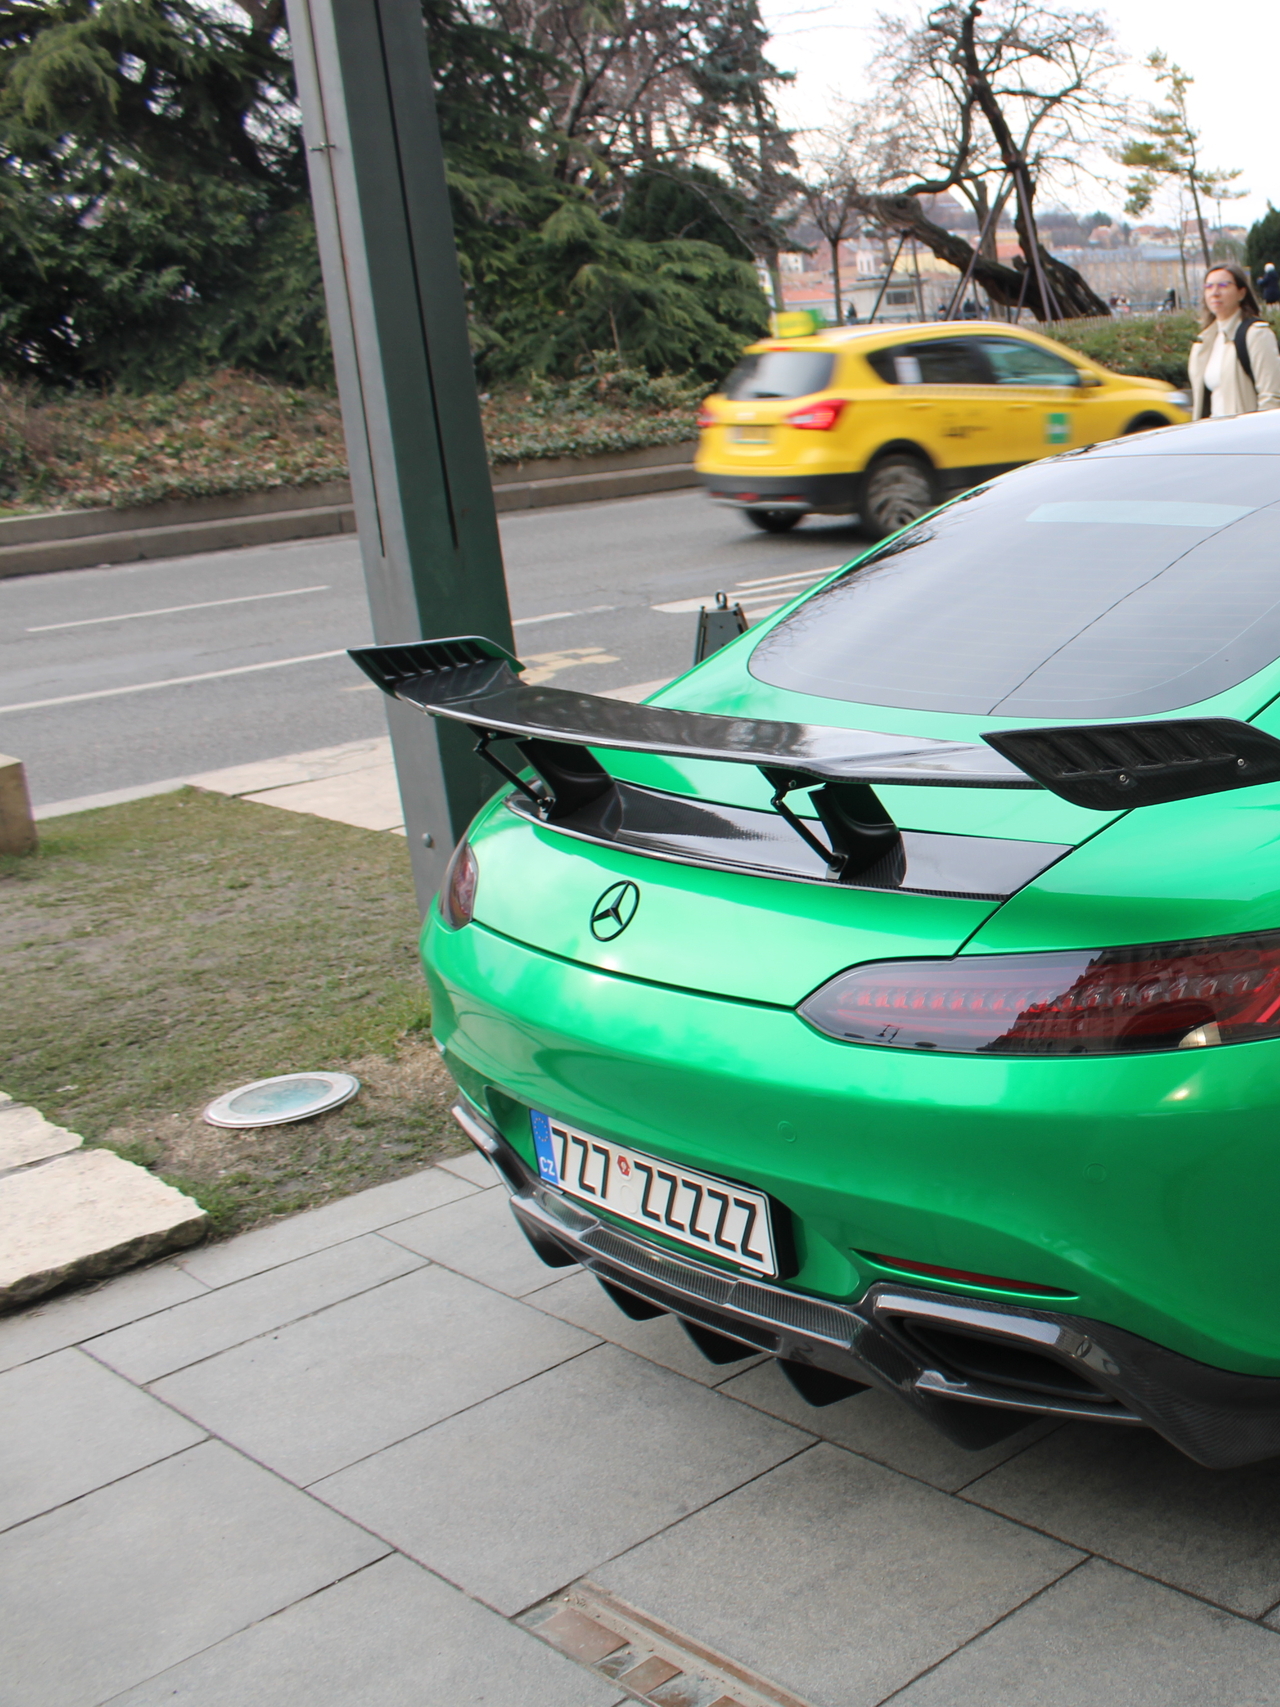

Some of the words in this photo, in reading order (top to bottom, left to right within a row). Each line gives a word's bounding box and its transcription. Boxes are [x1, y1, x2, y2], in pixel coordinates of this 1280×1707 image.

[540, 1156, 555, 1177] CZ
[552, 1126, 610, 1200] 7Z7
[634, 1159, 764, 1263] ZZZZZ
